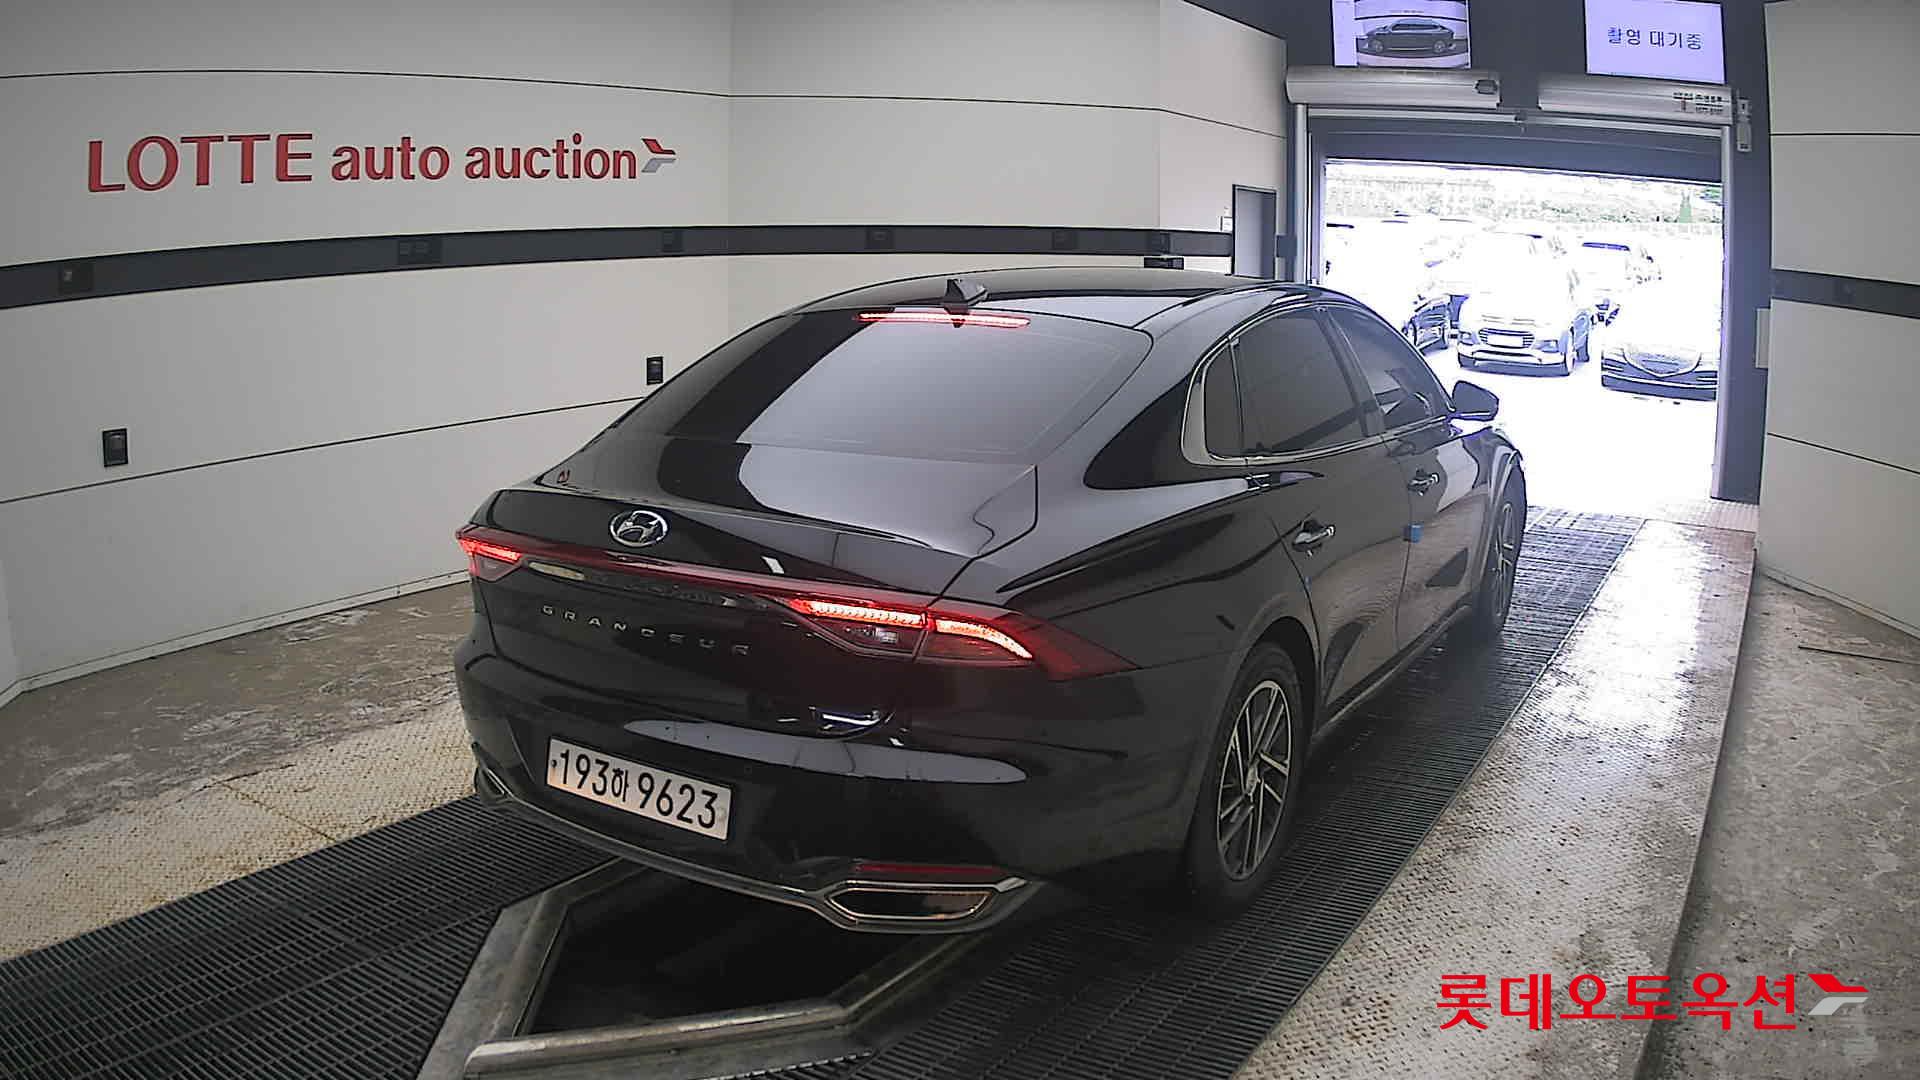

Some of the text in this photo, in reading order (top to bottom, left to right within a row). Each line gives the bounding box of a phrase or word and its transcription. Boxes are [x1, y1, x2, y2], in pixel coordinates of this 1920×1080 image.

[1649, 31, 1702, 50] 대기중
[88, 133, 638, 192] LOTTE auto auction
[542, 604, 750, 656] GRANDEUR
[637, 772, 719, 829] 9623
